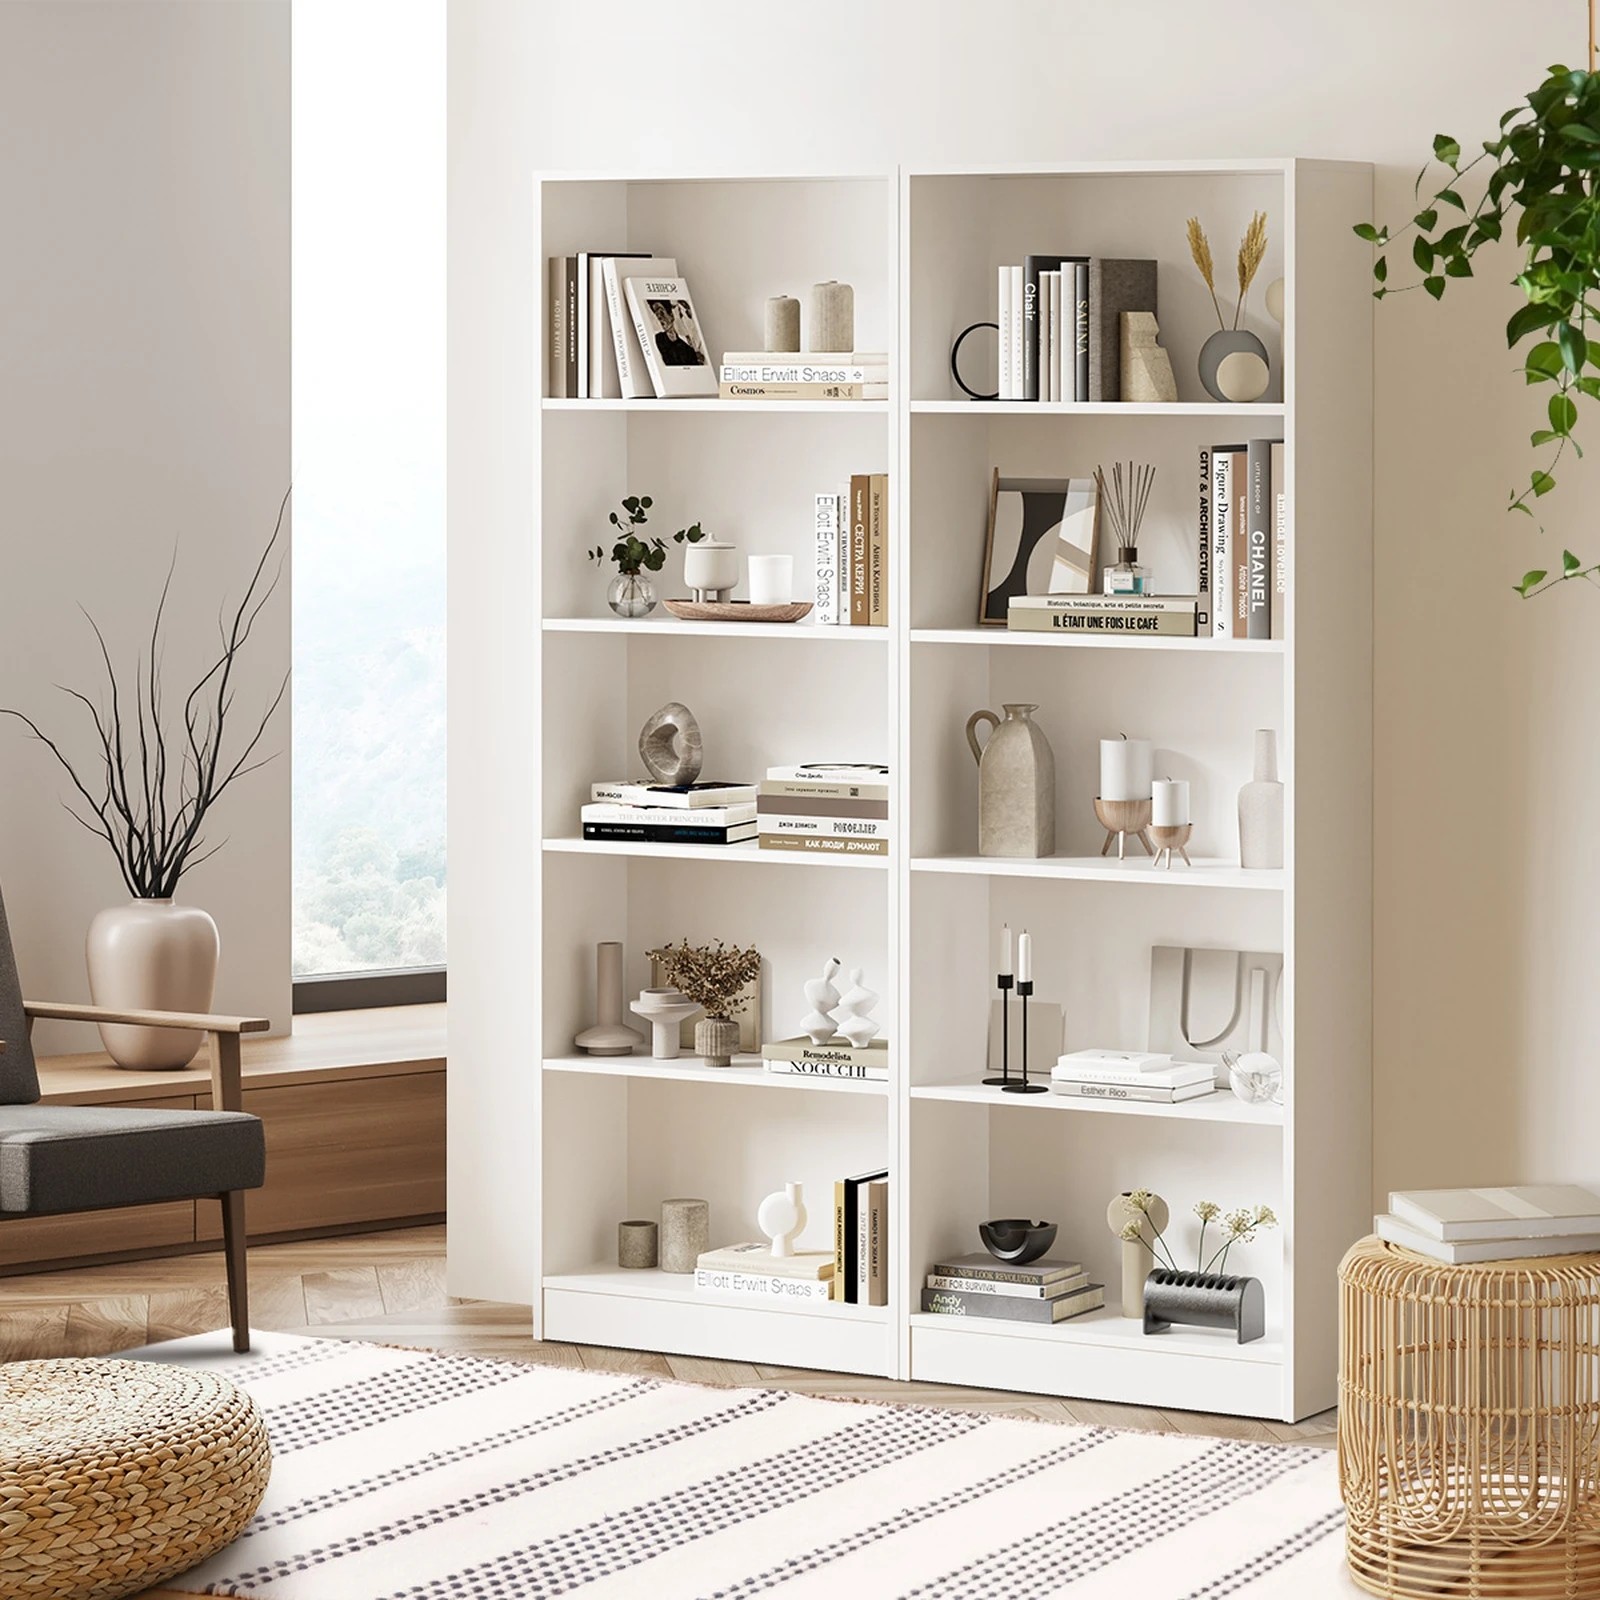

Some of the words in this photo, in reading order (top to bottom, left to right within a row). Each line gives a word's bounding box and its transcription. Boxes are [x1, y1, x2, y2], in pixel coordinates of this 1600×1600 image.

[1025, 283, 1036, 320] Chair
[1077, 300, 1088, 356] SAUNA
[723, 367, 758, 382] Elliott
[762, 367, 798, 382] Erwitt
[729, 385, 765, 395] Cosmos
[1199, 451, 1208, 480] CITY
[1199, 483, 1208, 492] &
[1216, 460, 1229, 499] Figure
[817, 497, 834, 528] Elliott
[1216, 503, 1229, 554] Drawing
[817, 532, 834, 565] Erwitt
[855, 524, 864, 560] СЕСТРА
[1199, 496, 1208, 592] ARCHITECTURE
[855, 563, 864, 595] КЕРРИ
[1252, 531, 1265, 613] CHANEL
[1047, 600, 1071, 608] Histoire,
[1073, 600, 1102, 609] botanique,
[1125, 602, 1142, 610] petits
[1053, 615, 1061, 628] IL
[1062, 613, 1087, 629] ÉTAIT
[1087, 616, 1104, 629] UNE
[1105, 616, 1124, 630] FOIS
[1126, 617, 1136, 630] LE
[1137, 615, 1158, 630] CAFÉ
[833, 822, 877, 834] РОКФЕЛЛЕР
[805, 839, 821, 849] КАК
[821, 840, 845, 850] ЛЮДИ
[846, 841, 880, 852] ДУМАЮТ
[803, 1050, 852, 1062] Remodelista
[790, 1060, 866, 1078] NOGUCHI
[1081, 1085, 1107, 1096] Esther
[1108, 1087, 1127, 1098] Rico
[733, 1274, 768, 1293] Erwitt
[958, 1268, 973, 1278] NEW
[974, 1270, 994, 1280] LOOK
[995, 1271, 1039, 1284] REVOLUTION
[933, 1278, 947, 1288] ART
[948, 1279, 964, 1290] FOR
[965, 1281, 997, 1294] SURVIVAL
[933, 1293, 962, 1307] Andy
[928, 1303, 966, 1316] Warhol
